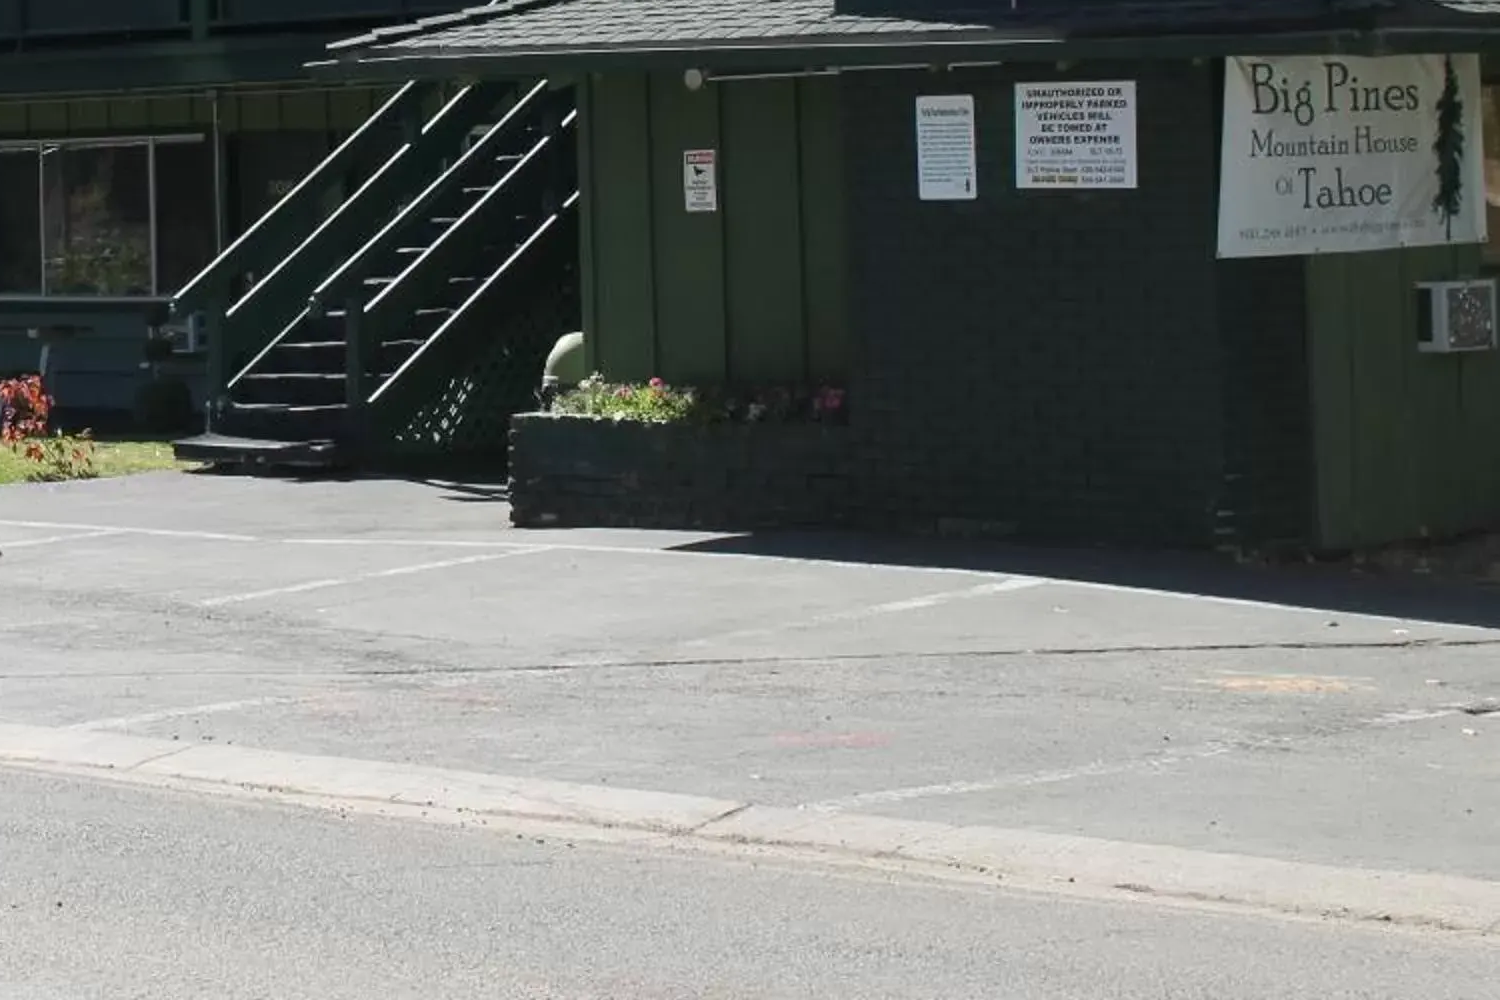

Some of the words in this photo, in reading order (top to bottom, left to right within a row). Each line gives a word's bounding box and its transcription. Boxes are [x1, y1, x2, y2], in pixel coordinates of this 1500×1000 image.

[1026, 87, 1105, 98] UNAUTHORIZED
[1106, 87, 1123, 97] OR
[1250, 62, 1315, 126] Big
[1322, 61, 1420, 113] Pines
[1021, 99, 1086, 109] IMPROPERLY
[1086, 99, 1128, 109] PARKED
[1036, 111, 1085, 121] VEHICLES
[1087, 111, 1113, 121] WILL
[1041, 123, 1055, 133] BE
[1057, 123, 1093, 133] TOWED
[1094, 123, 1109, 133] AT
[1029, 135, 1073, 145] OWNERS
[1073, 135, 1121, 145] EXPENSE
[1250, 129, 1350, 158] Mountain
[1354, 125, 1419, 154] House
[1297, 167, 1393, 210] Tahoe
